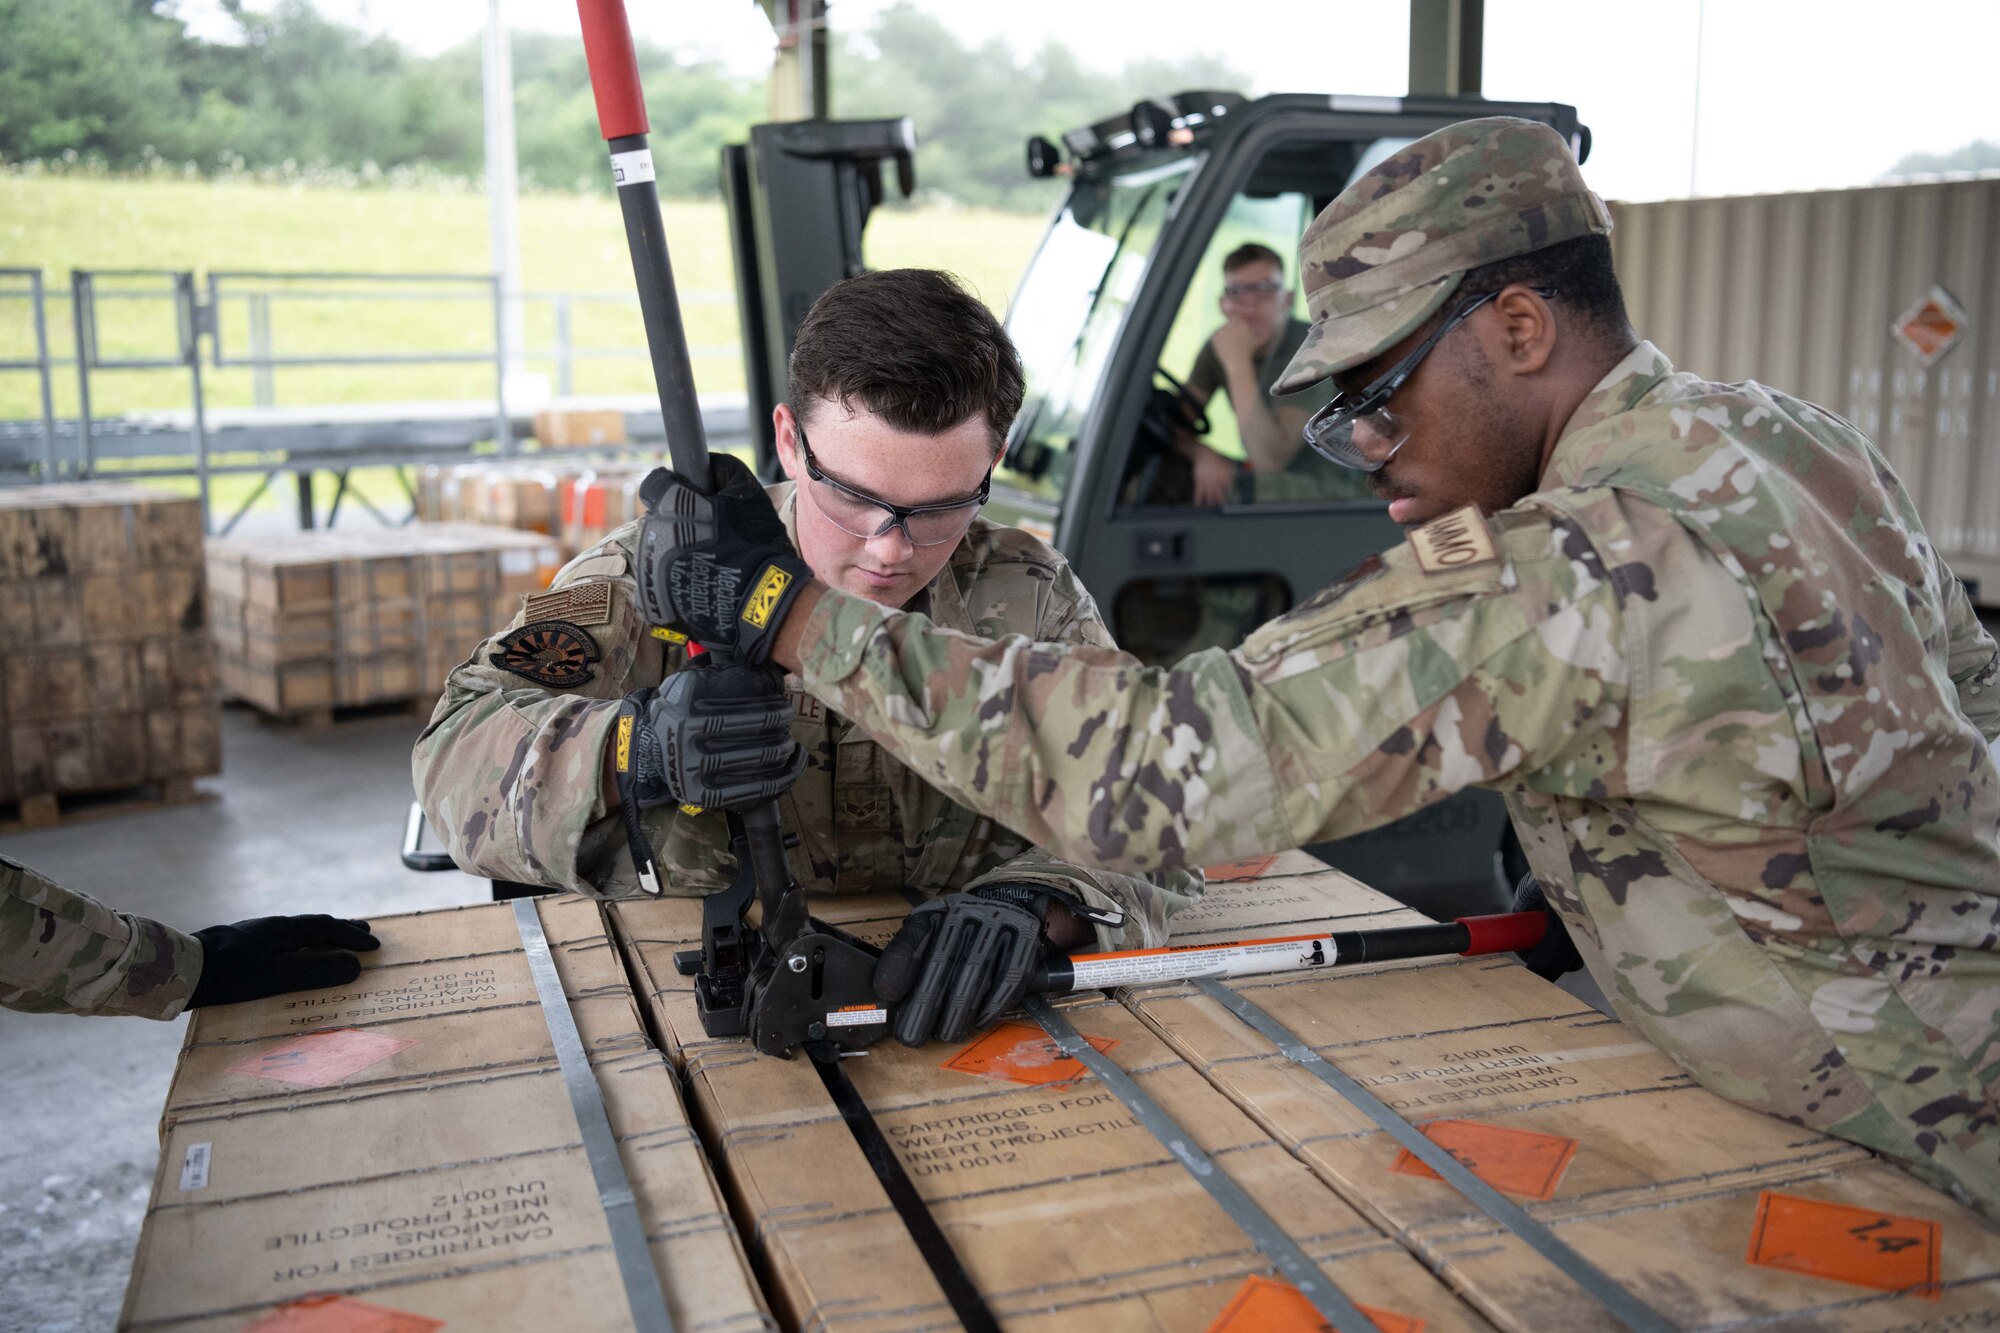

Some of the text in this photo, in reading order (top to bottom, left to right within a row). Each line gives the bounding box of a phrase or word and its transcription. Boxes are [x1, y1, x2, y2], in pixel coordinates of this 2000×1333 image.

[1425, 515, 1478, 564] AMMO
[692, 552, 717, 617] Mechanix
[718, 566, 742, 630] Mechanix
[1202, 895, 1310, 911] PROJECTILE
[408, 969, 494, 984] UN 0012
[284, 977, 496, 1010] INERT PROJECTILE
[290, 992, 497, 1026] CARTRIDGES FOR
[844, 1004, 876, 1012] WARNING
[1440, 1045, 1528, 1063] UN 0012
[1483, 1055, 1545, 1071] INERT
[1385, 1076, 1578, 1110] CARTRIDGES FO
[890, 1092, 1114, 1137] CARTRIDGES FOR
[905, 1143, 984, 1164] INERT
[914, 1152, 1021, 1178] UN 0012
[432, 1180, 546, 1208] UN 0012
[265, 1196, 548, 1249] INERT PROJECTILE
[272, 1225, 554, 1282] CARTRIDGES FOR
